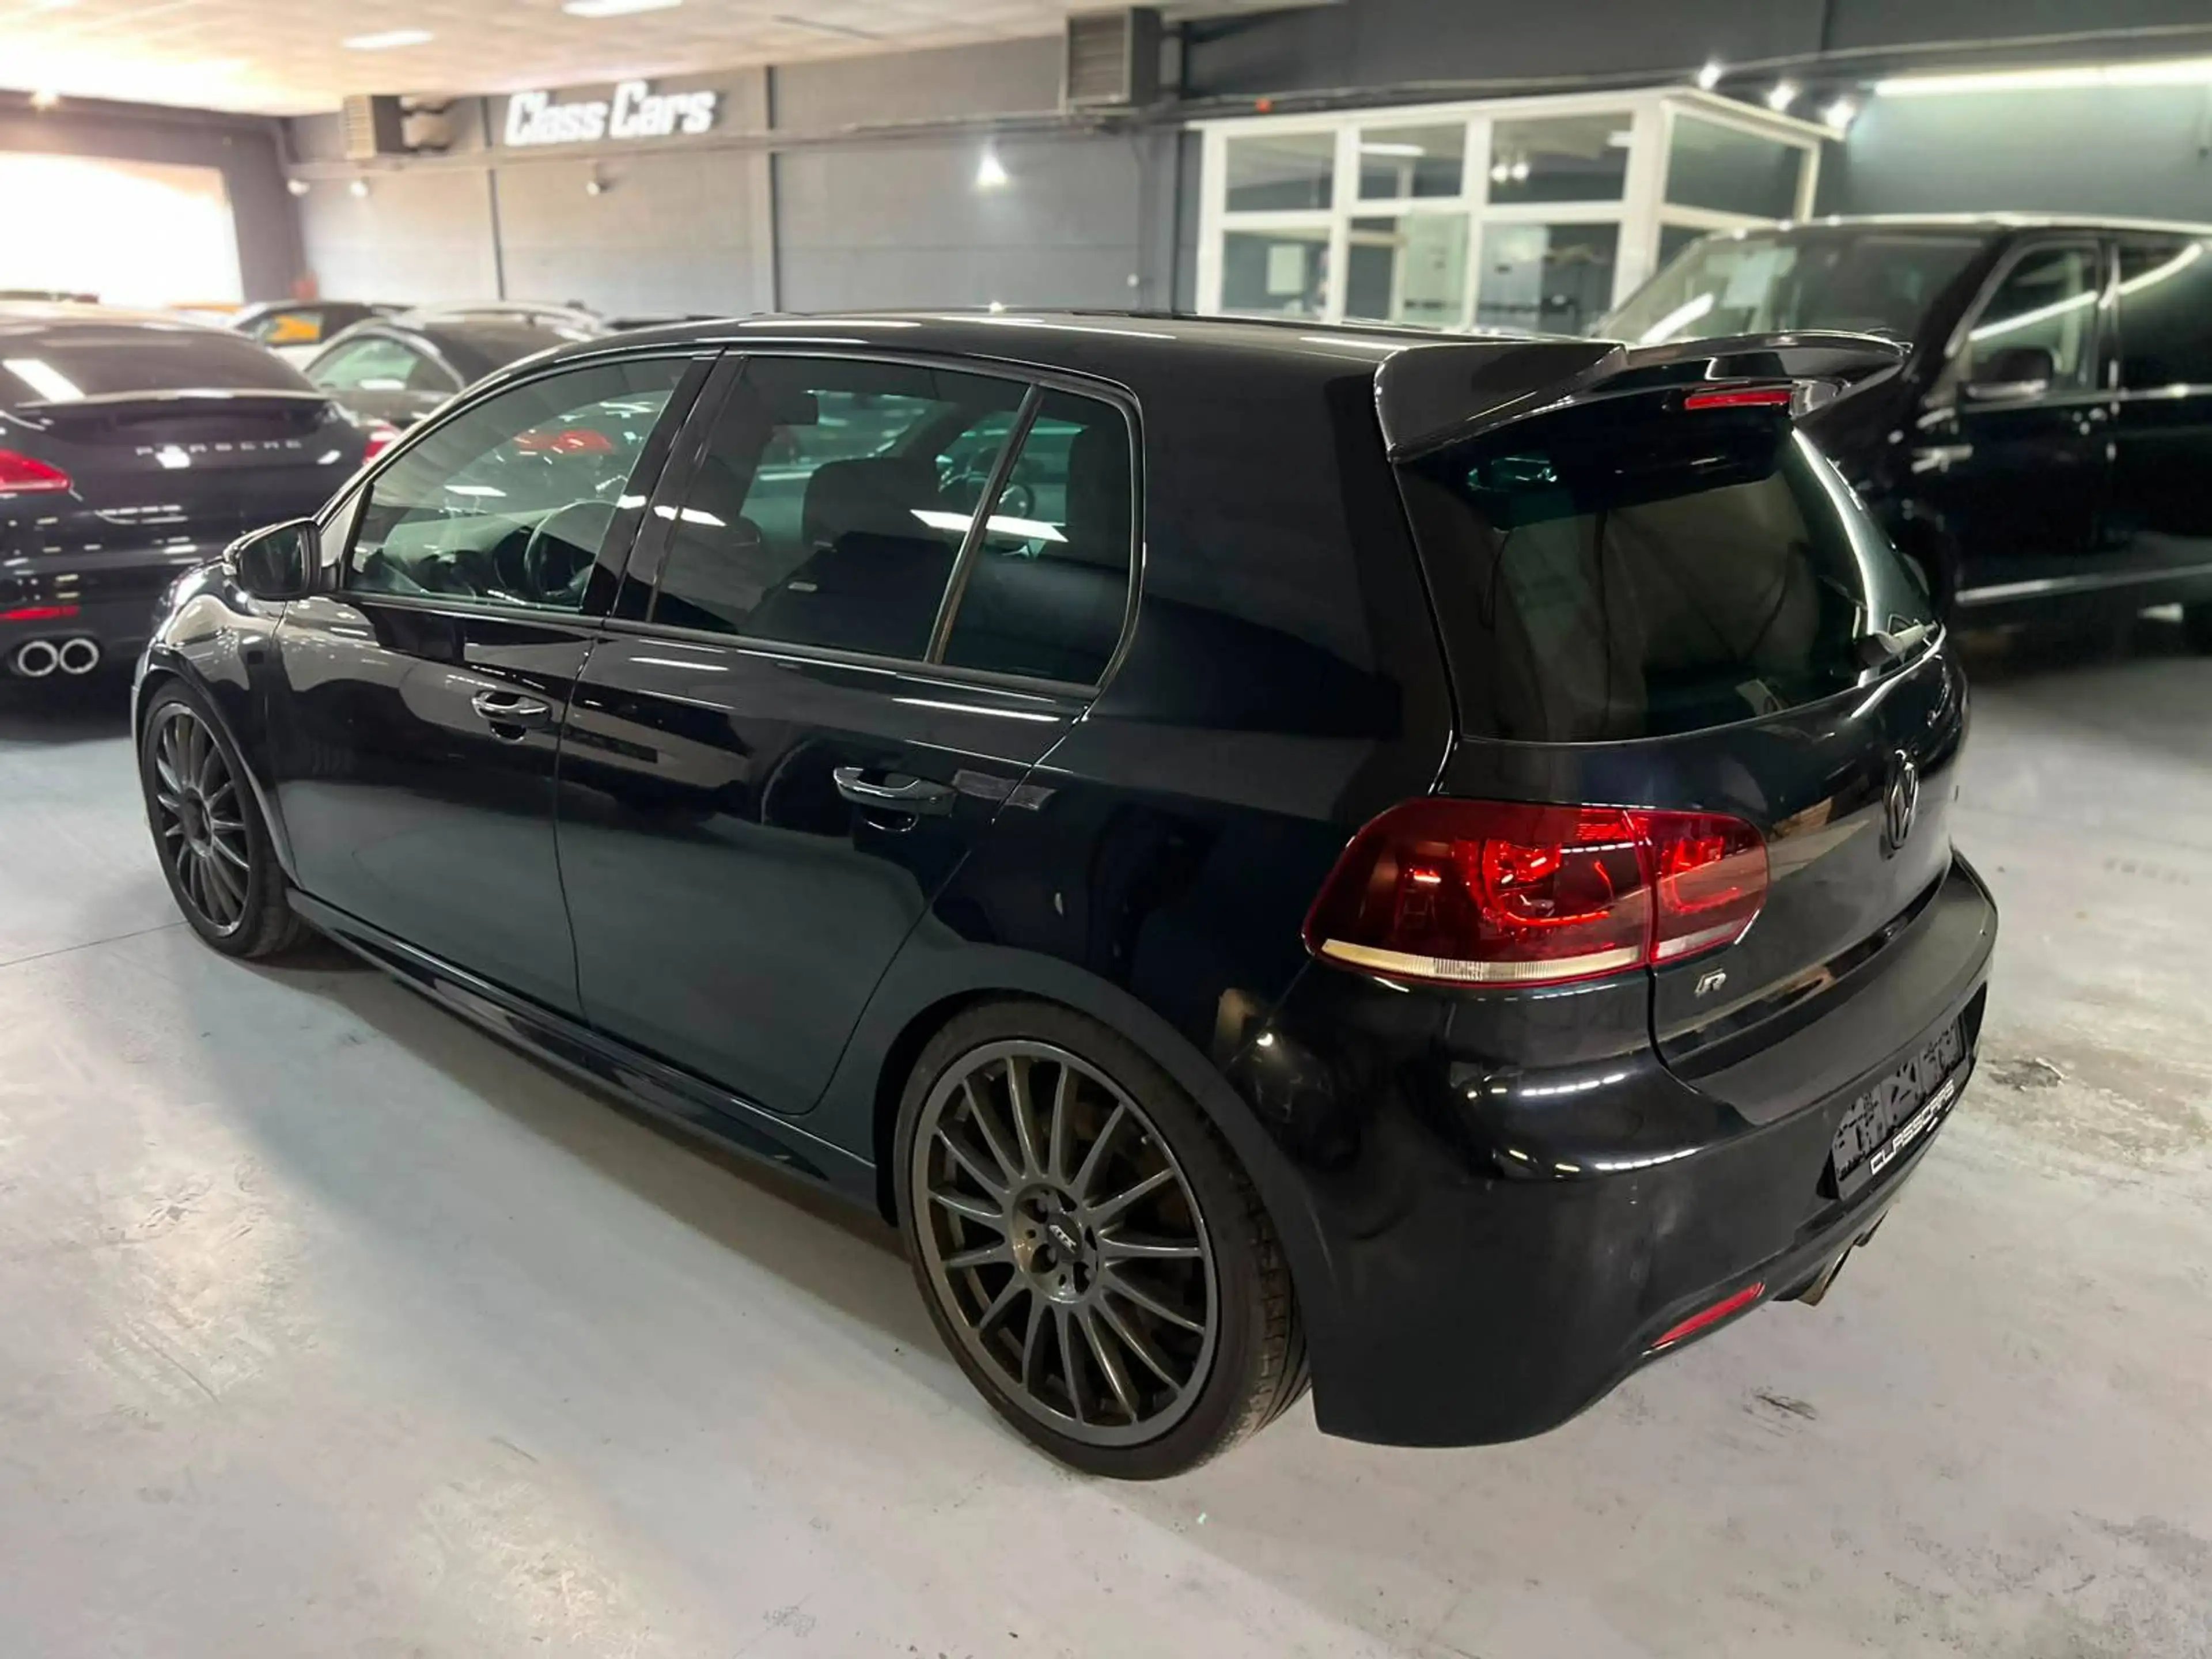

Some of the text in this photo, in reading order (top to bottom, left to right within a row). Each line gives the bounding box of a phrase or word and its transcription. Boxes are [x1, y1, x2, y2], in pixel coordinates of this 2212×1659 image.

[608, 79, 717, 139] Cars
[136, 438, 302, 456] PRSCHE
[1695, 968, 1726, 997] R
